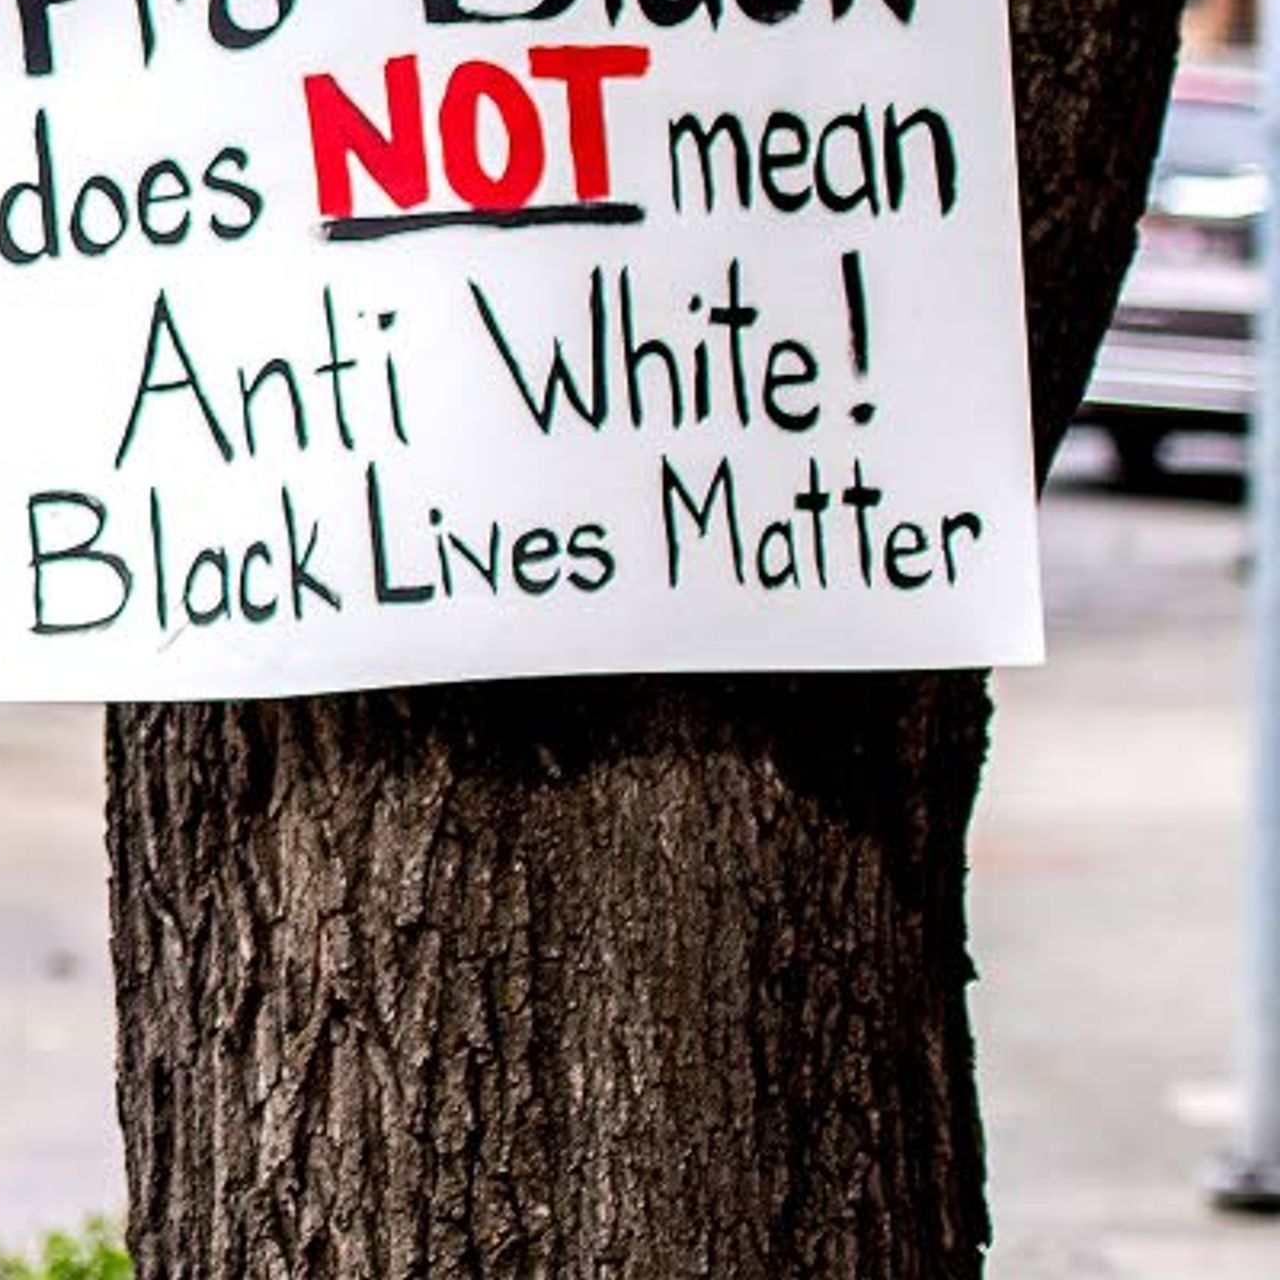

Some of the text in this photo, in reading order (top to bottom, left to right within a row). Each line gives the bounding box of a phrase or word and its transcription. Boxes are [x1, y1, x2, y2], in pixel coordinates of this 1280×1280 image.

[303, 45, 650, 217] NOT
[669, 104, 956, 216] mean
[116, 251, 875, 469] Anti White!
[28, 456, 981, 634] Black Lives Matter
